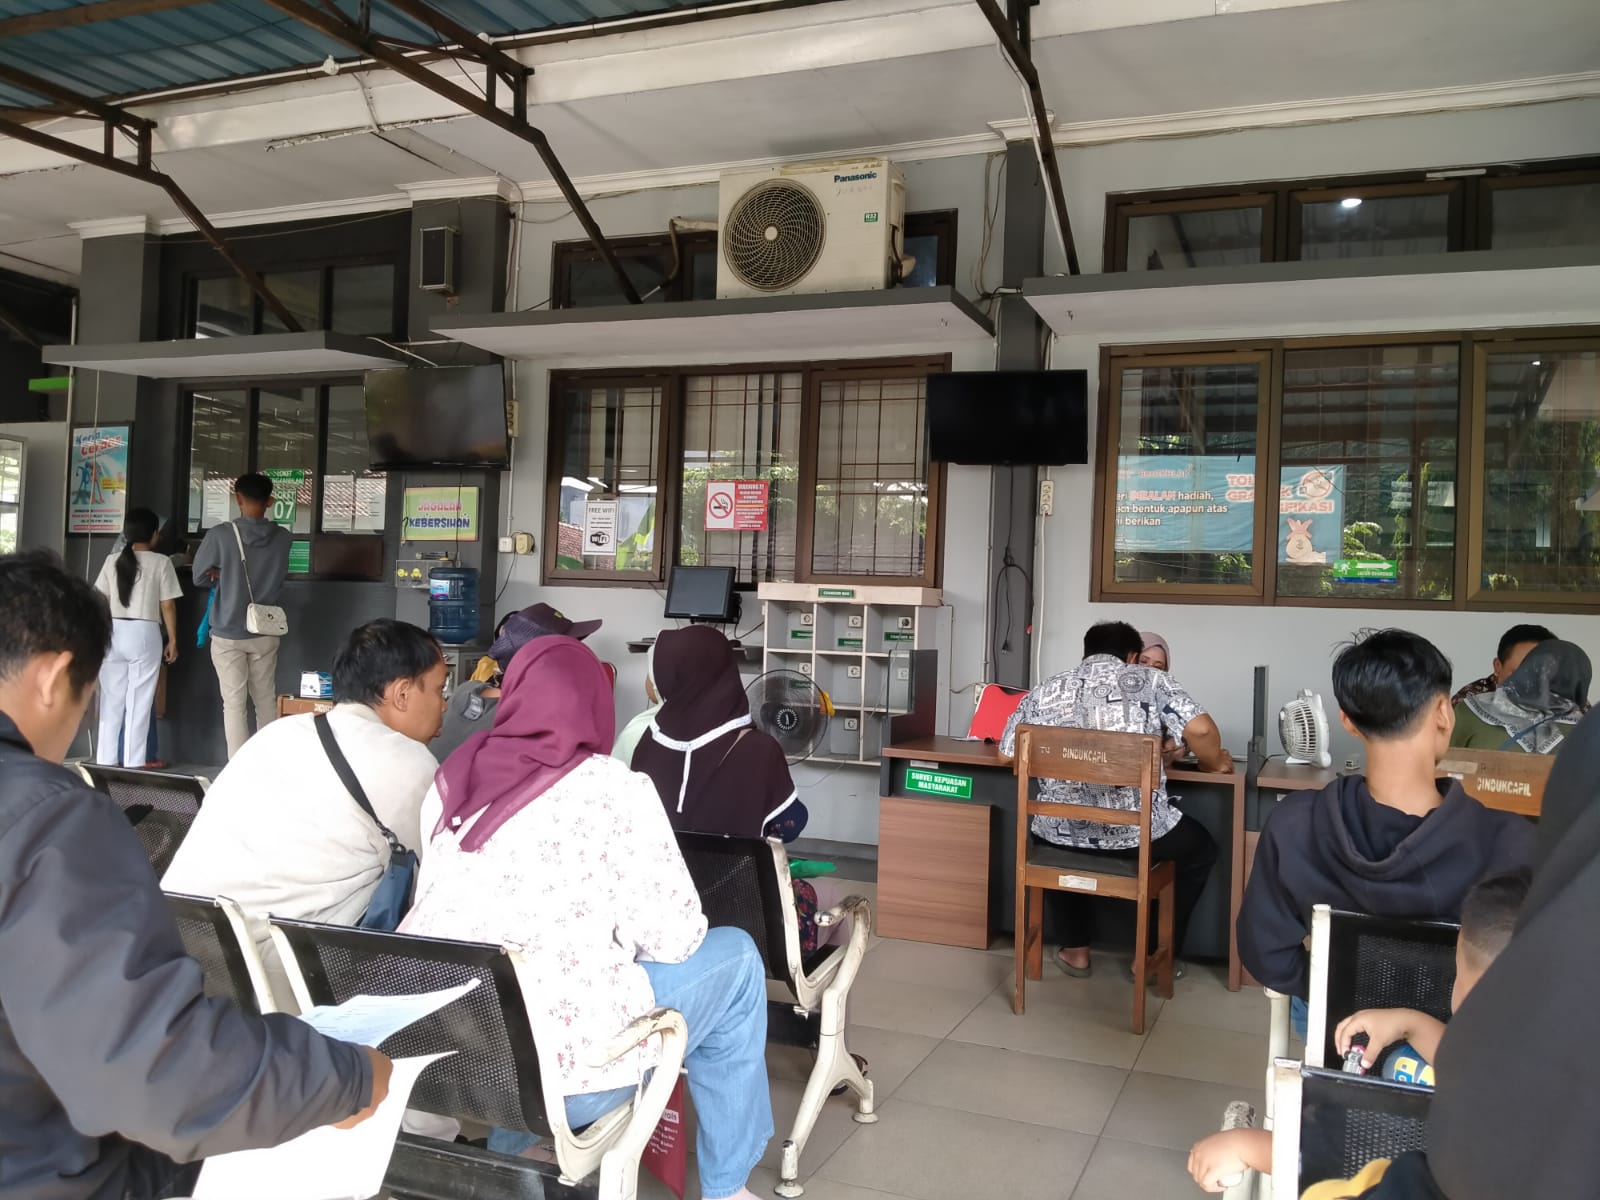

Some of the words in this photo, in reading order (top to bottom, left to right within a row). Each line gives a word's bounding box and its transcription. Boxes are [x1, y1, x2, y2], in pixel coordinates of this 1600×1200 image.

[834, 171, 877, 182] Panasonic
[1178, 491, 1214, 500] hadiah,
[274, 500, 294, 519] 07
[1132, 504, 1166, 513] bentuk
[1168, 505, 1204, 515] apapun
[1206, 504, 1228, 512] atas
[409, 518, 470, 528] KEBERSIHAN
[1126, 517, 1161, 526] berikan
[912, 772, 932, 782] SURVEI
[934, 776, 967, 786] KEPUASAN
[918, 781, 958, 793] MASYARAKAT
